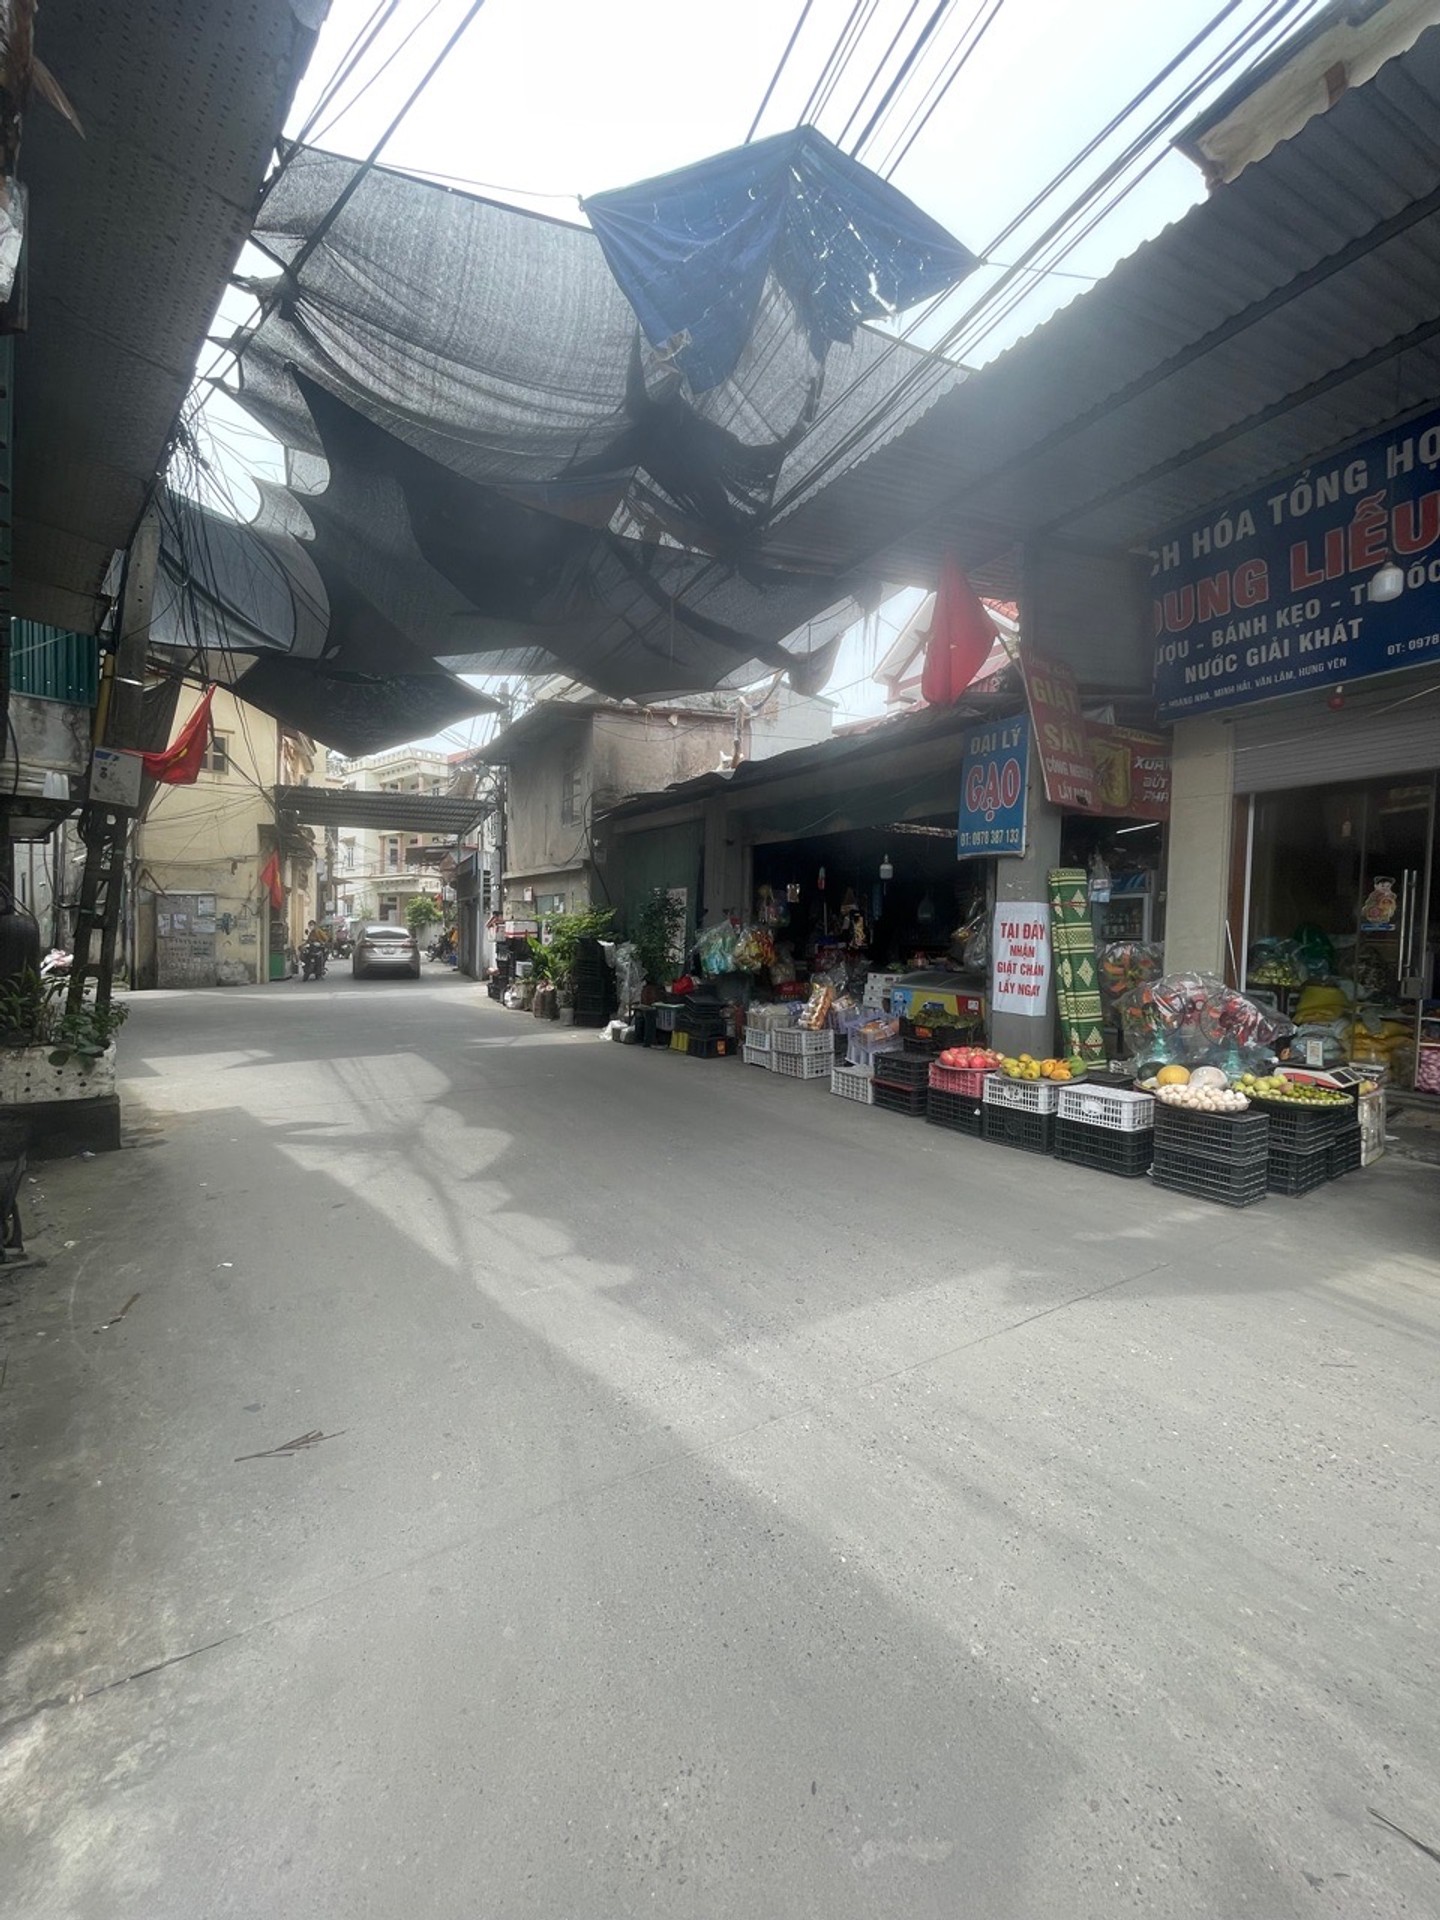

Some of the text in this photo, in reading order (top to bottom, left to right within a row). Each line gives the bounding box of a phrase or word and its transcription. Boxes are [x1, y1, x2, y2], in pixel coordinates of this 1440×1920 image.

[1192, 510, 1256, 559] HÓA
[1267, 459, 1368, 525] TỔNG
[1290, 488, 1440, 592] LIỄU
[1211, 614, 1268, 648] BÁNH
[1276, 598, 1321, 628] KẸO
[1185, 618, 1363, 684] NƯỚC GIẢI KHÁT
[1326, 656, 1347, 671] YÊN
[970, 723, 1022, 757] ĐẠI LÝ
[965, 757, 1022, 822] GẠO
[990, 829, 1004, 845] 387
[1006, 828, 1020, 844] 133
[1000, 919, 1046, 942] TẠI ĐÂY
[1009, 942, 1035, 960] NHẬN
[998, 977, 1041, 997] LẤY NGAY
